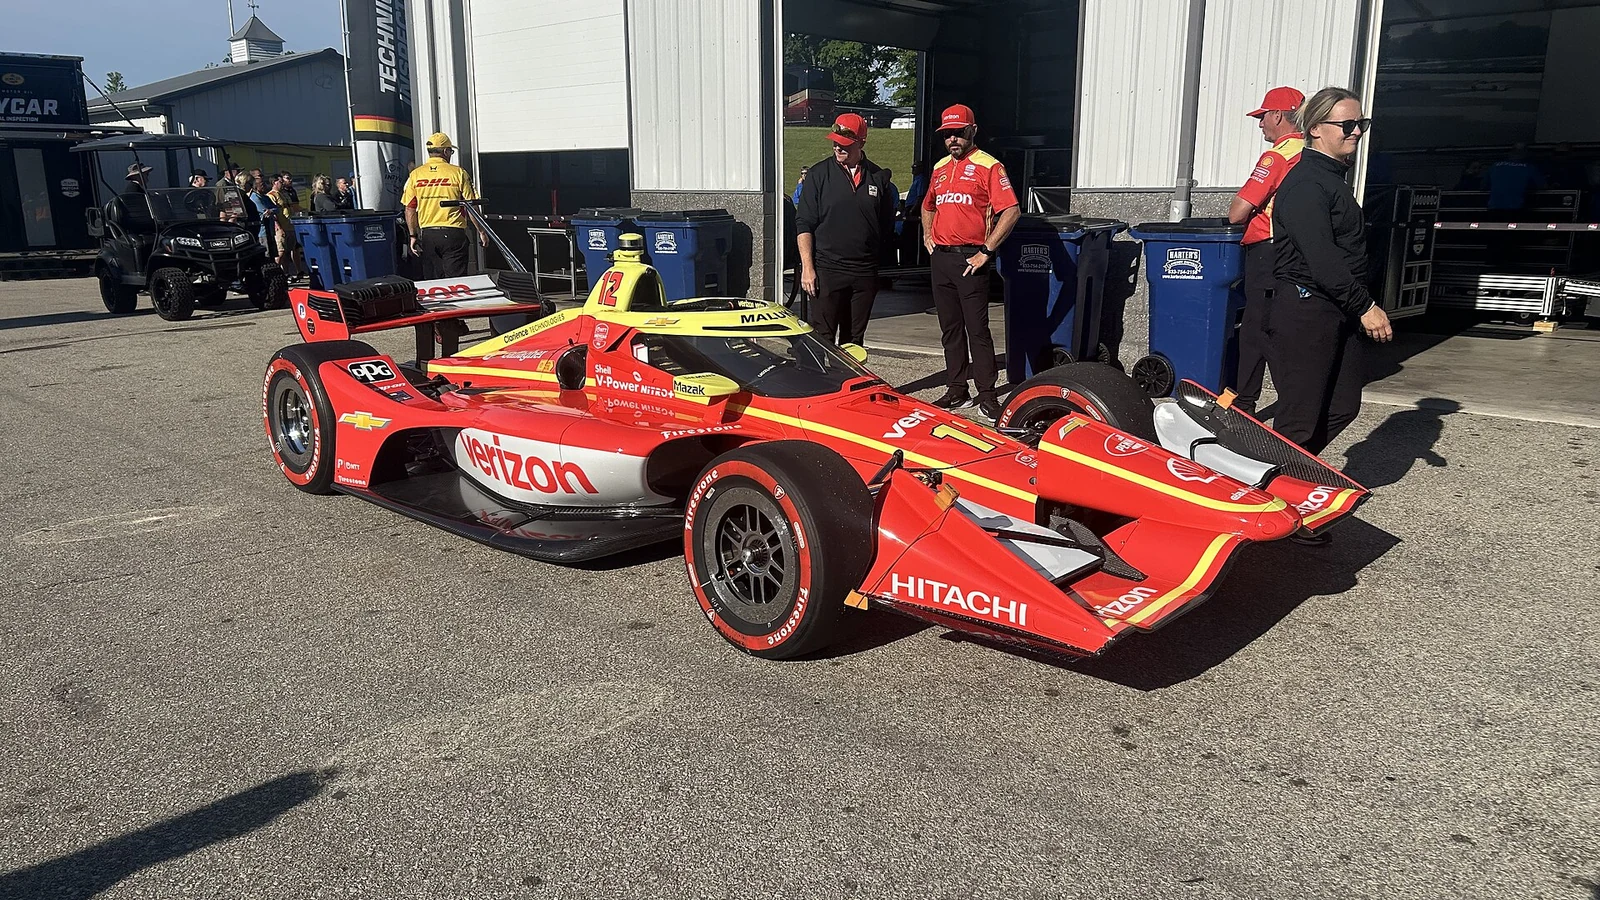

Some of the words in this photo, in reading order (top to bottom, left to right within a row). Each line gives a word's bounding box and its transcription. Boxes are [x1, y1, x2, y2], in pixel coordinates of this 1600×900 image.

[376, 0, 396, 93] TECHNI
[0, 98, 59, 116] YCAR
[415, 177, 452, 188] DHL
[935, 190, 973, 205] erizon
[1169, 250, 1199, 260] HARTER'S
[598, 271, 624, 307] 12
[503, 328, 529, 344] Clarience
[529, 312, 566, 334] TECHNOLOGIES
[594, 364, 612, 375] Shell
[595, 374, 639, 393] V-Power
[674, 379, 706, 396] Mazak
[660, 424, 742, 440] Firestone
[882, 408, 936, 439] veri
[459, 431, 600, 495] verizon
[685, 469, 719, 531] Firestone
[891, 572, 1028, 627] HITACHI
[767, 587, 809, 645] Firestone
